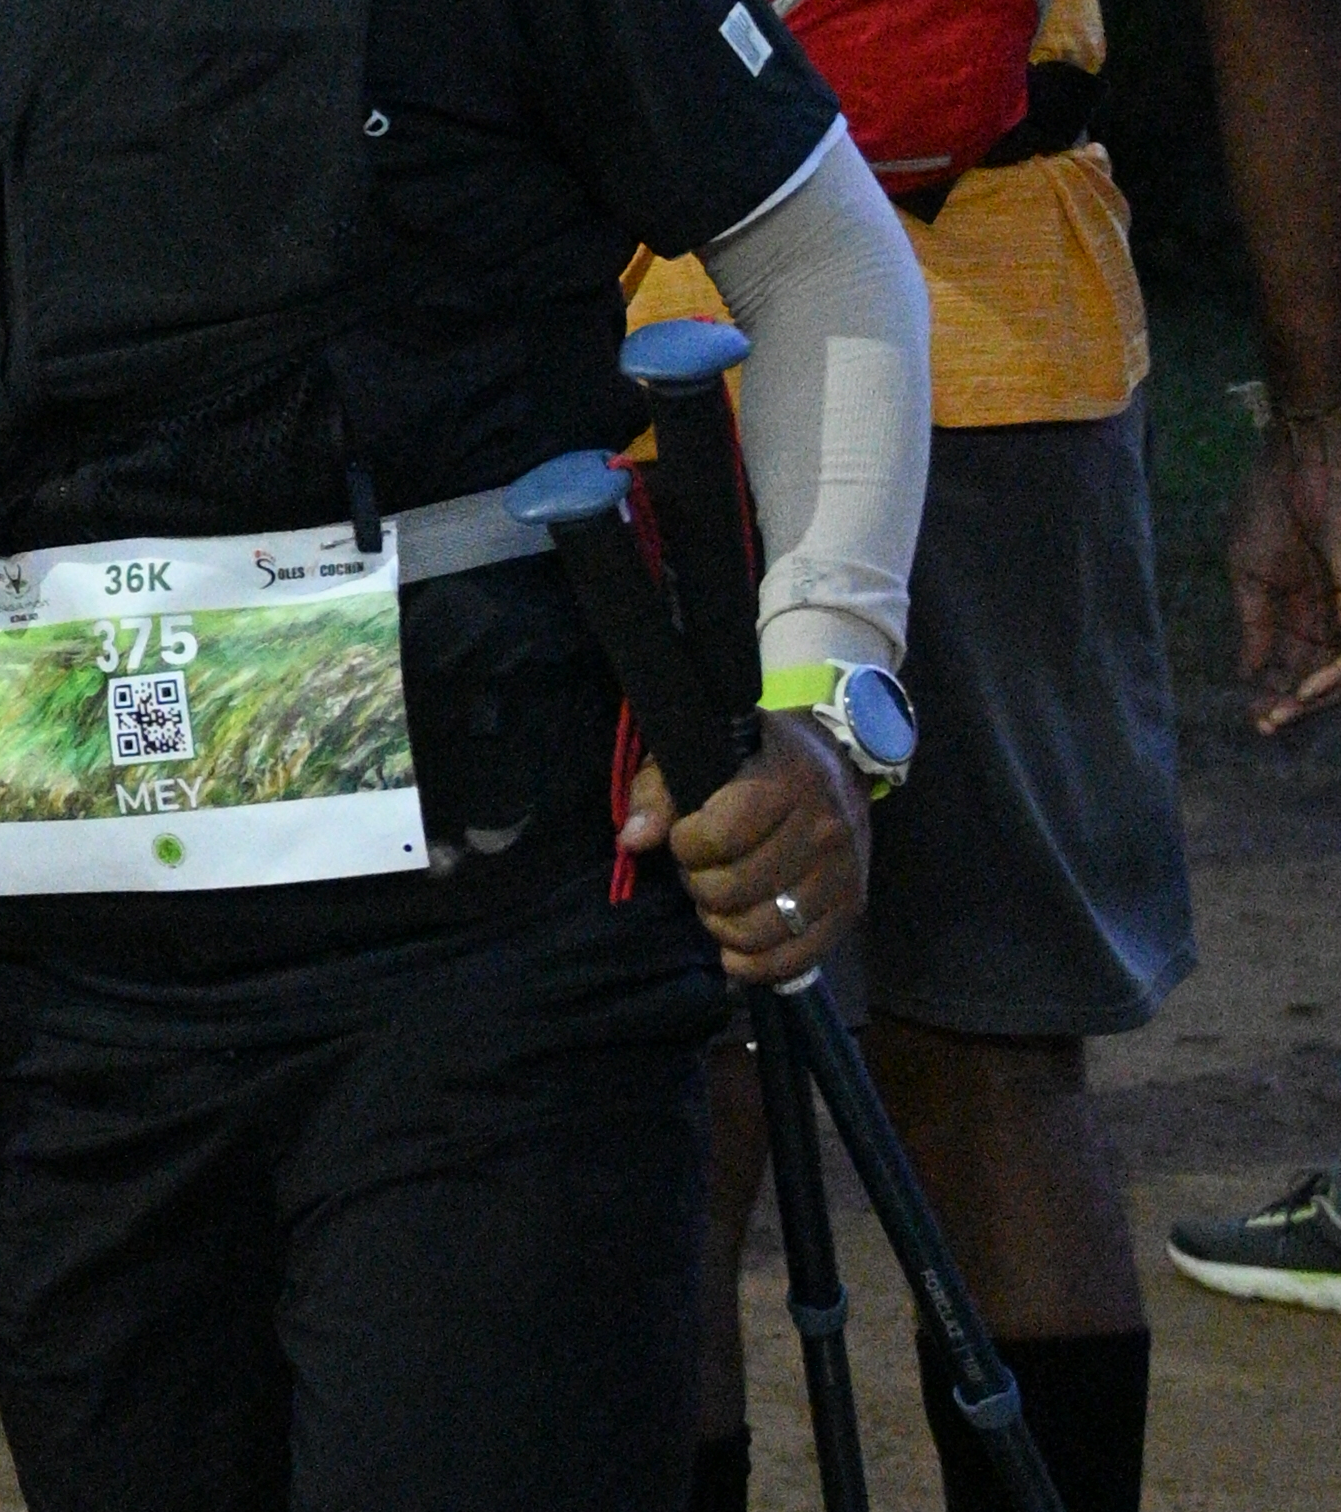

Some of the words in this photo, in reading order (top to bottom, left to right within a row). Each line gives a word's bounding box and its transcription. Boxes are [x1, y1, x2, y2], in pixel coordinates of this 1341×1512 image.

[104, 561, 173, 596] 36K
[92, 614, 199, 674] 375
[116, 778, 203, 815] MEY
